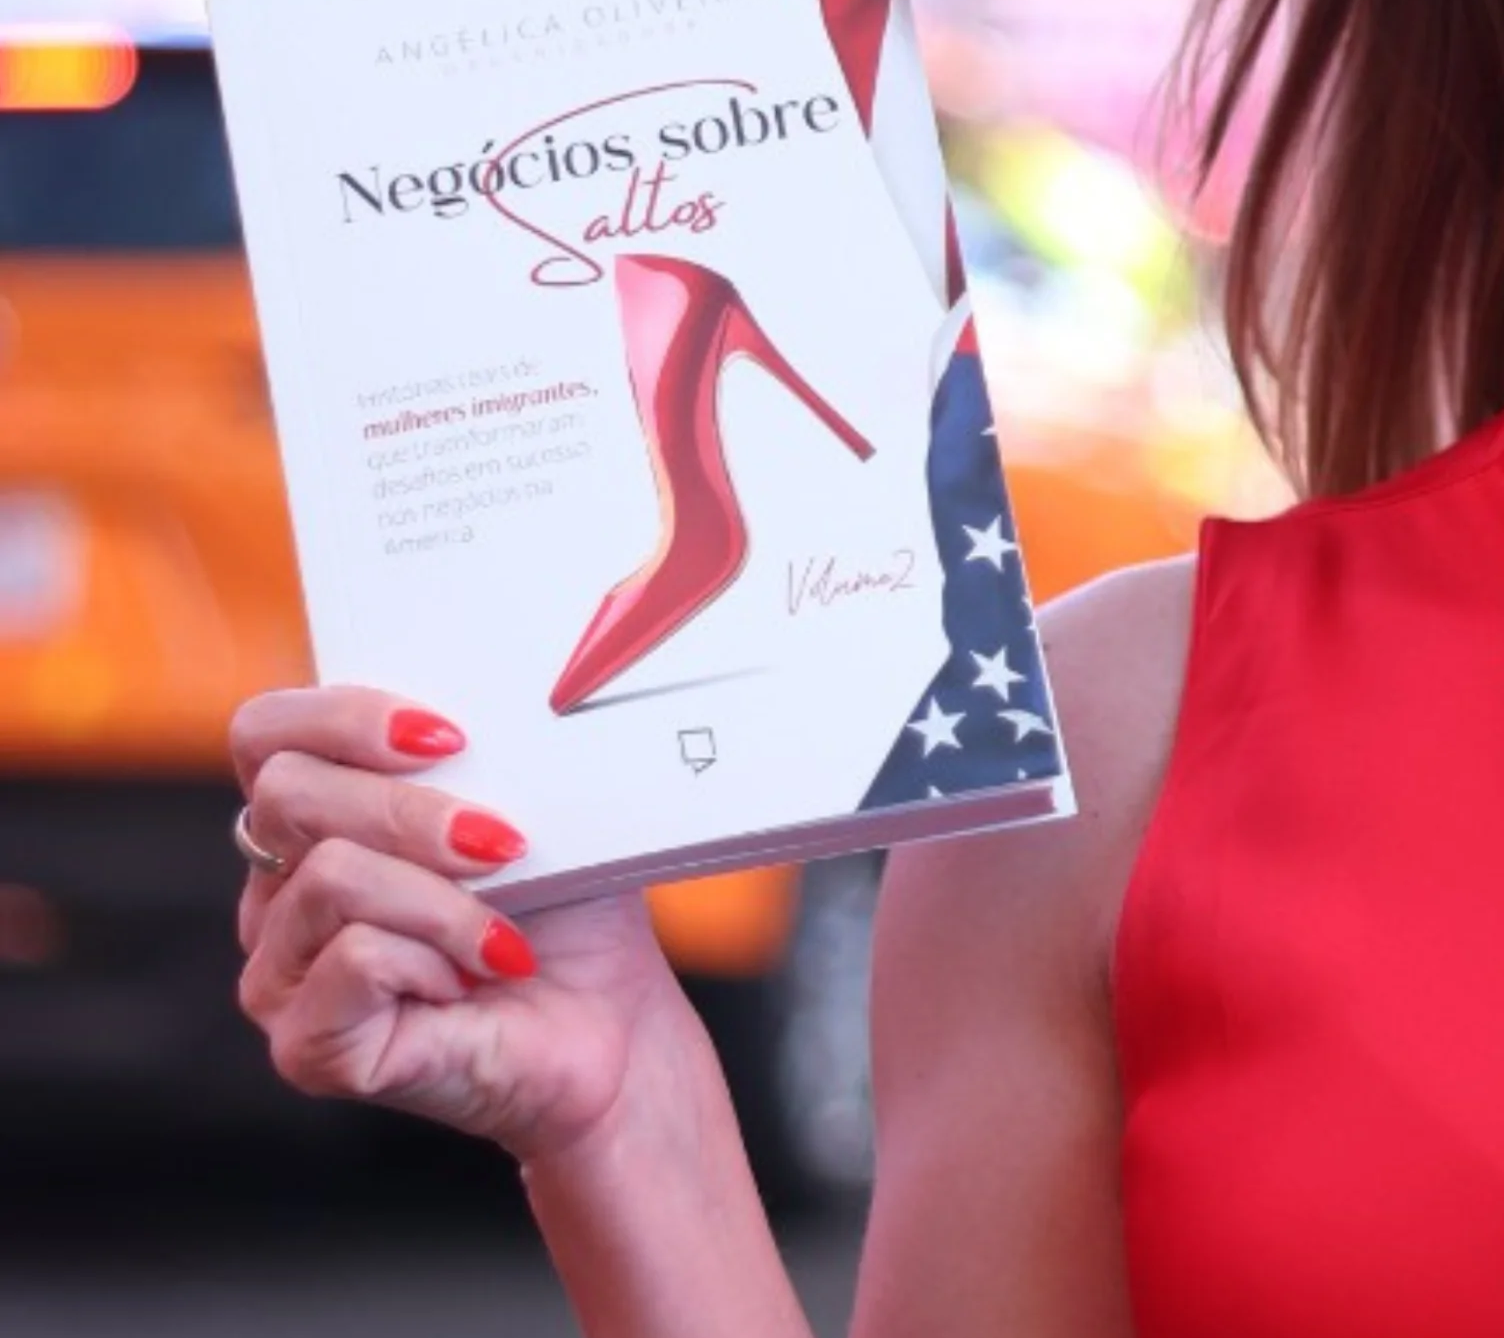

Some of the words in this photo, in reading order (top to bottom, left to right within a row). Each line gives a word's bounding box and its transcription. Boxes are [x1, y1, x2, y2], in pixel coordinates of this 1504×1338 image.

[335, 131, 636, 224] Negócios
[658, 91, 840, 162] sobre
[481, 78, 759, 287] Saltos
[363, 407, 467, 441] mulheres
